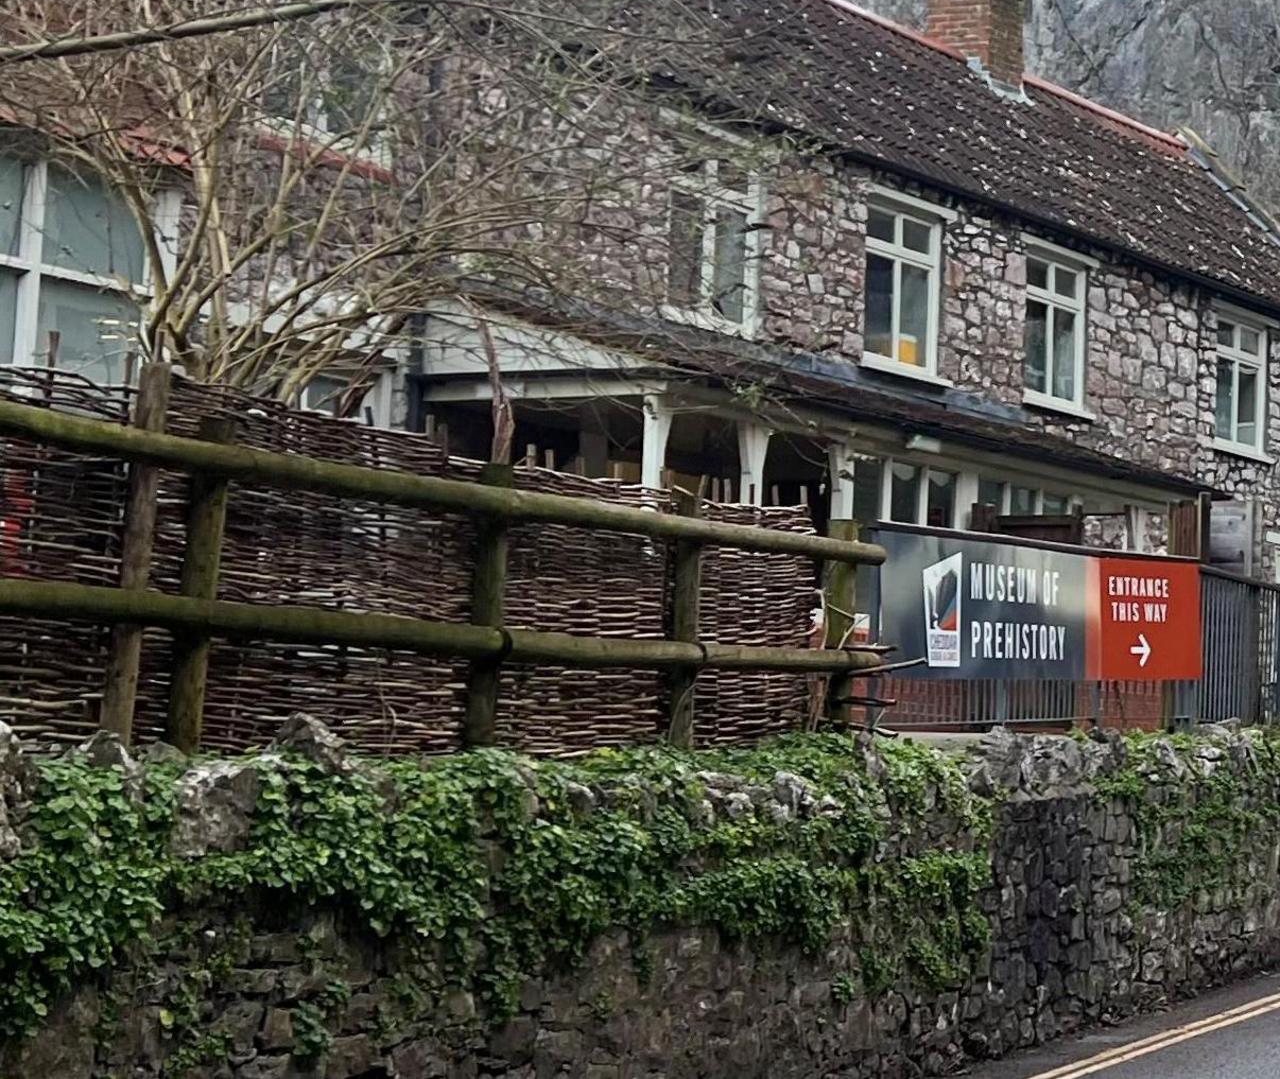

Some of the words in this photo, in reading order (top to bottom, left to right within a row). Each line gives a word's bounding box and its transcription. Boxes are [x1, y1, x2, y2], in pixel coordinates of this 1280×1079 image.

[970, 562, 1037, 604] MUSEUM
[1043, 570, 1060, 606] OF
[1108, 575, 1169, 598] ENTRANCE
[1111, 602, 1140, 622] THIS
[1143, 603, 1167, 622] WAY
[970, 620, 1066, 661] PREHISTORY
